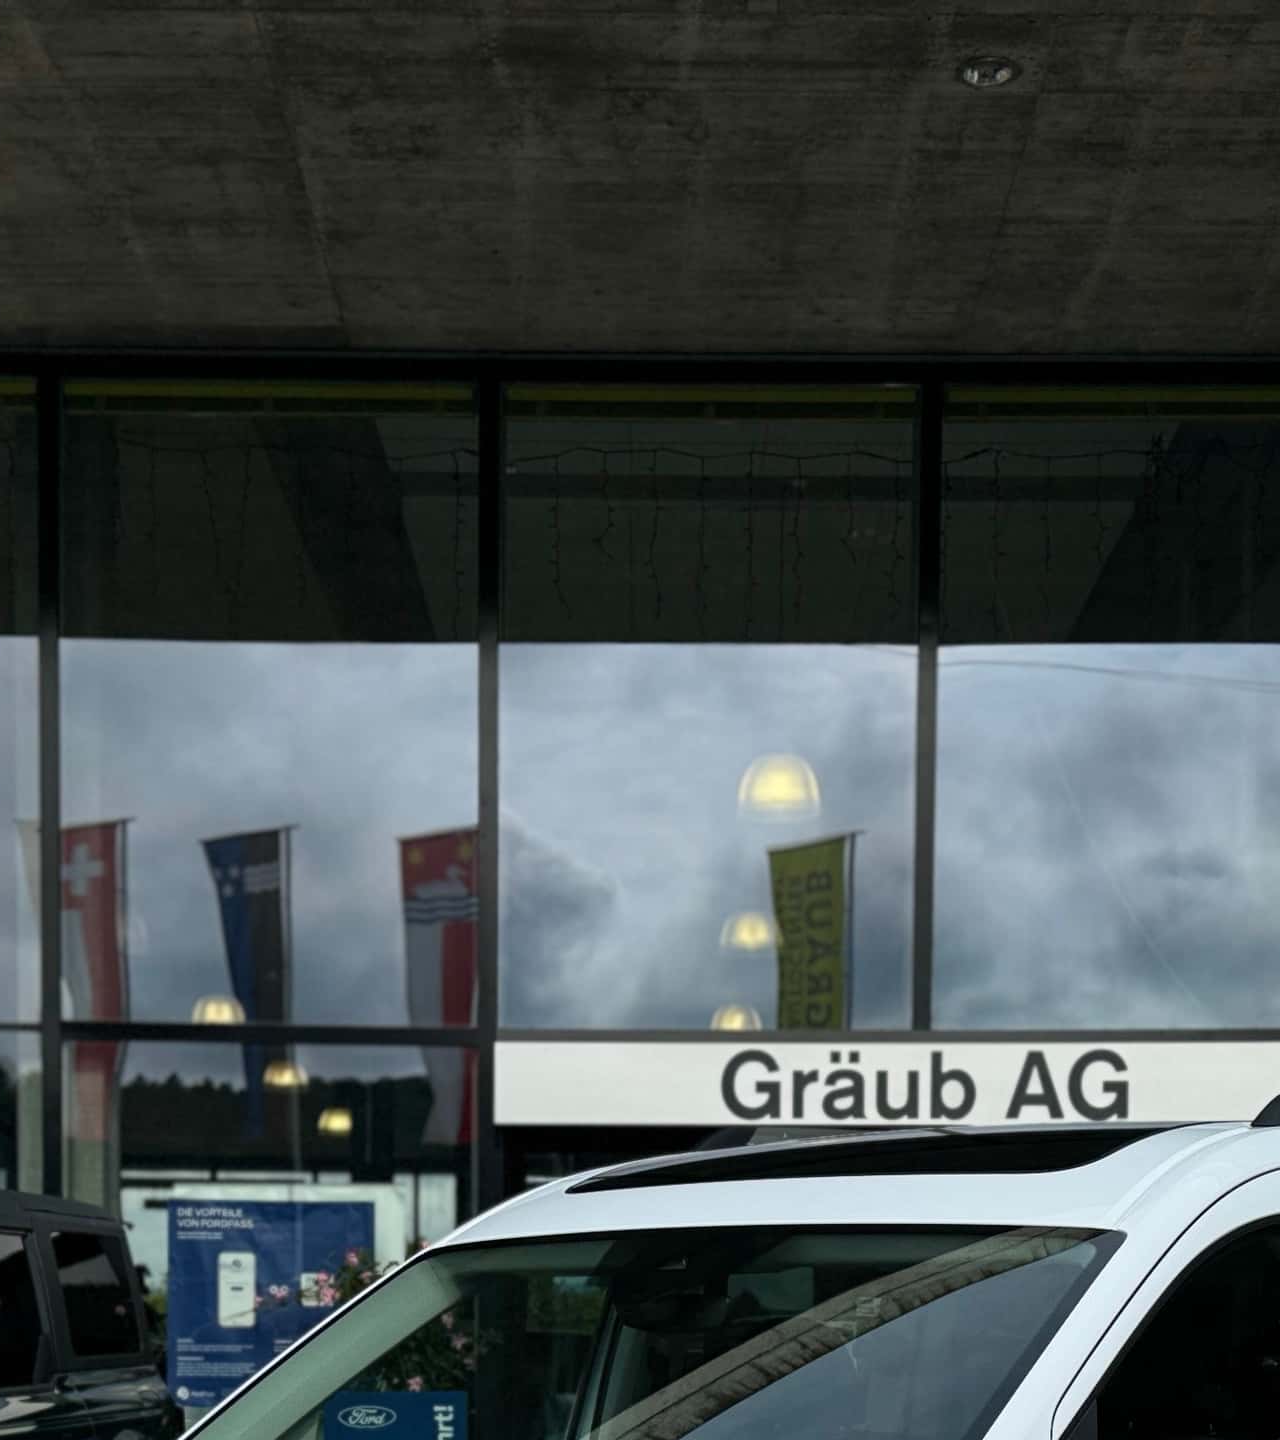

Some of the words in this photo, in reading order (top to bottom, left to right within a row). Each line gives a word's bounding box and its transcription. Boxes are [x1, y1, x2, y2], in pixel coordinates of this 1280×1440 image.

[720, 1048, 977, 1121] Gräub
[1005, 1048, 1130, 1121] AG
[346, 1408, 388, 1426] Ford
